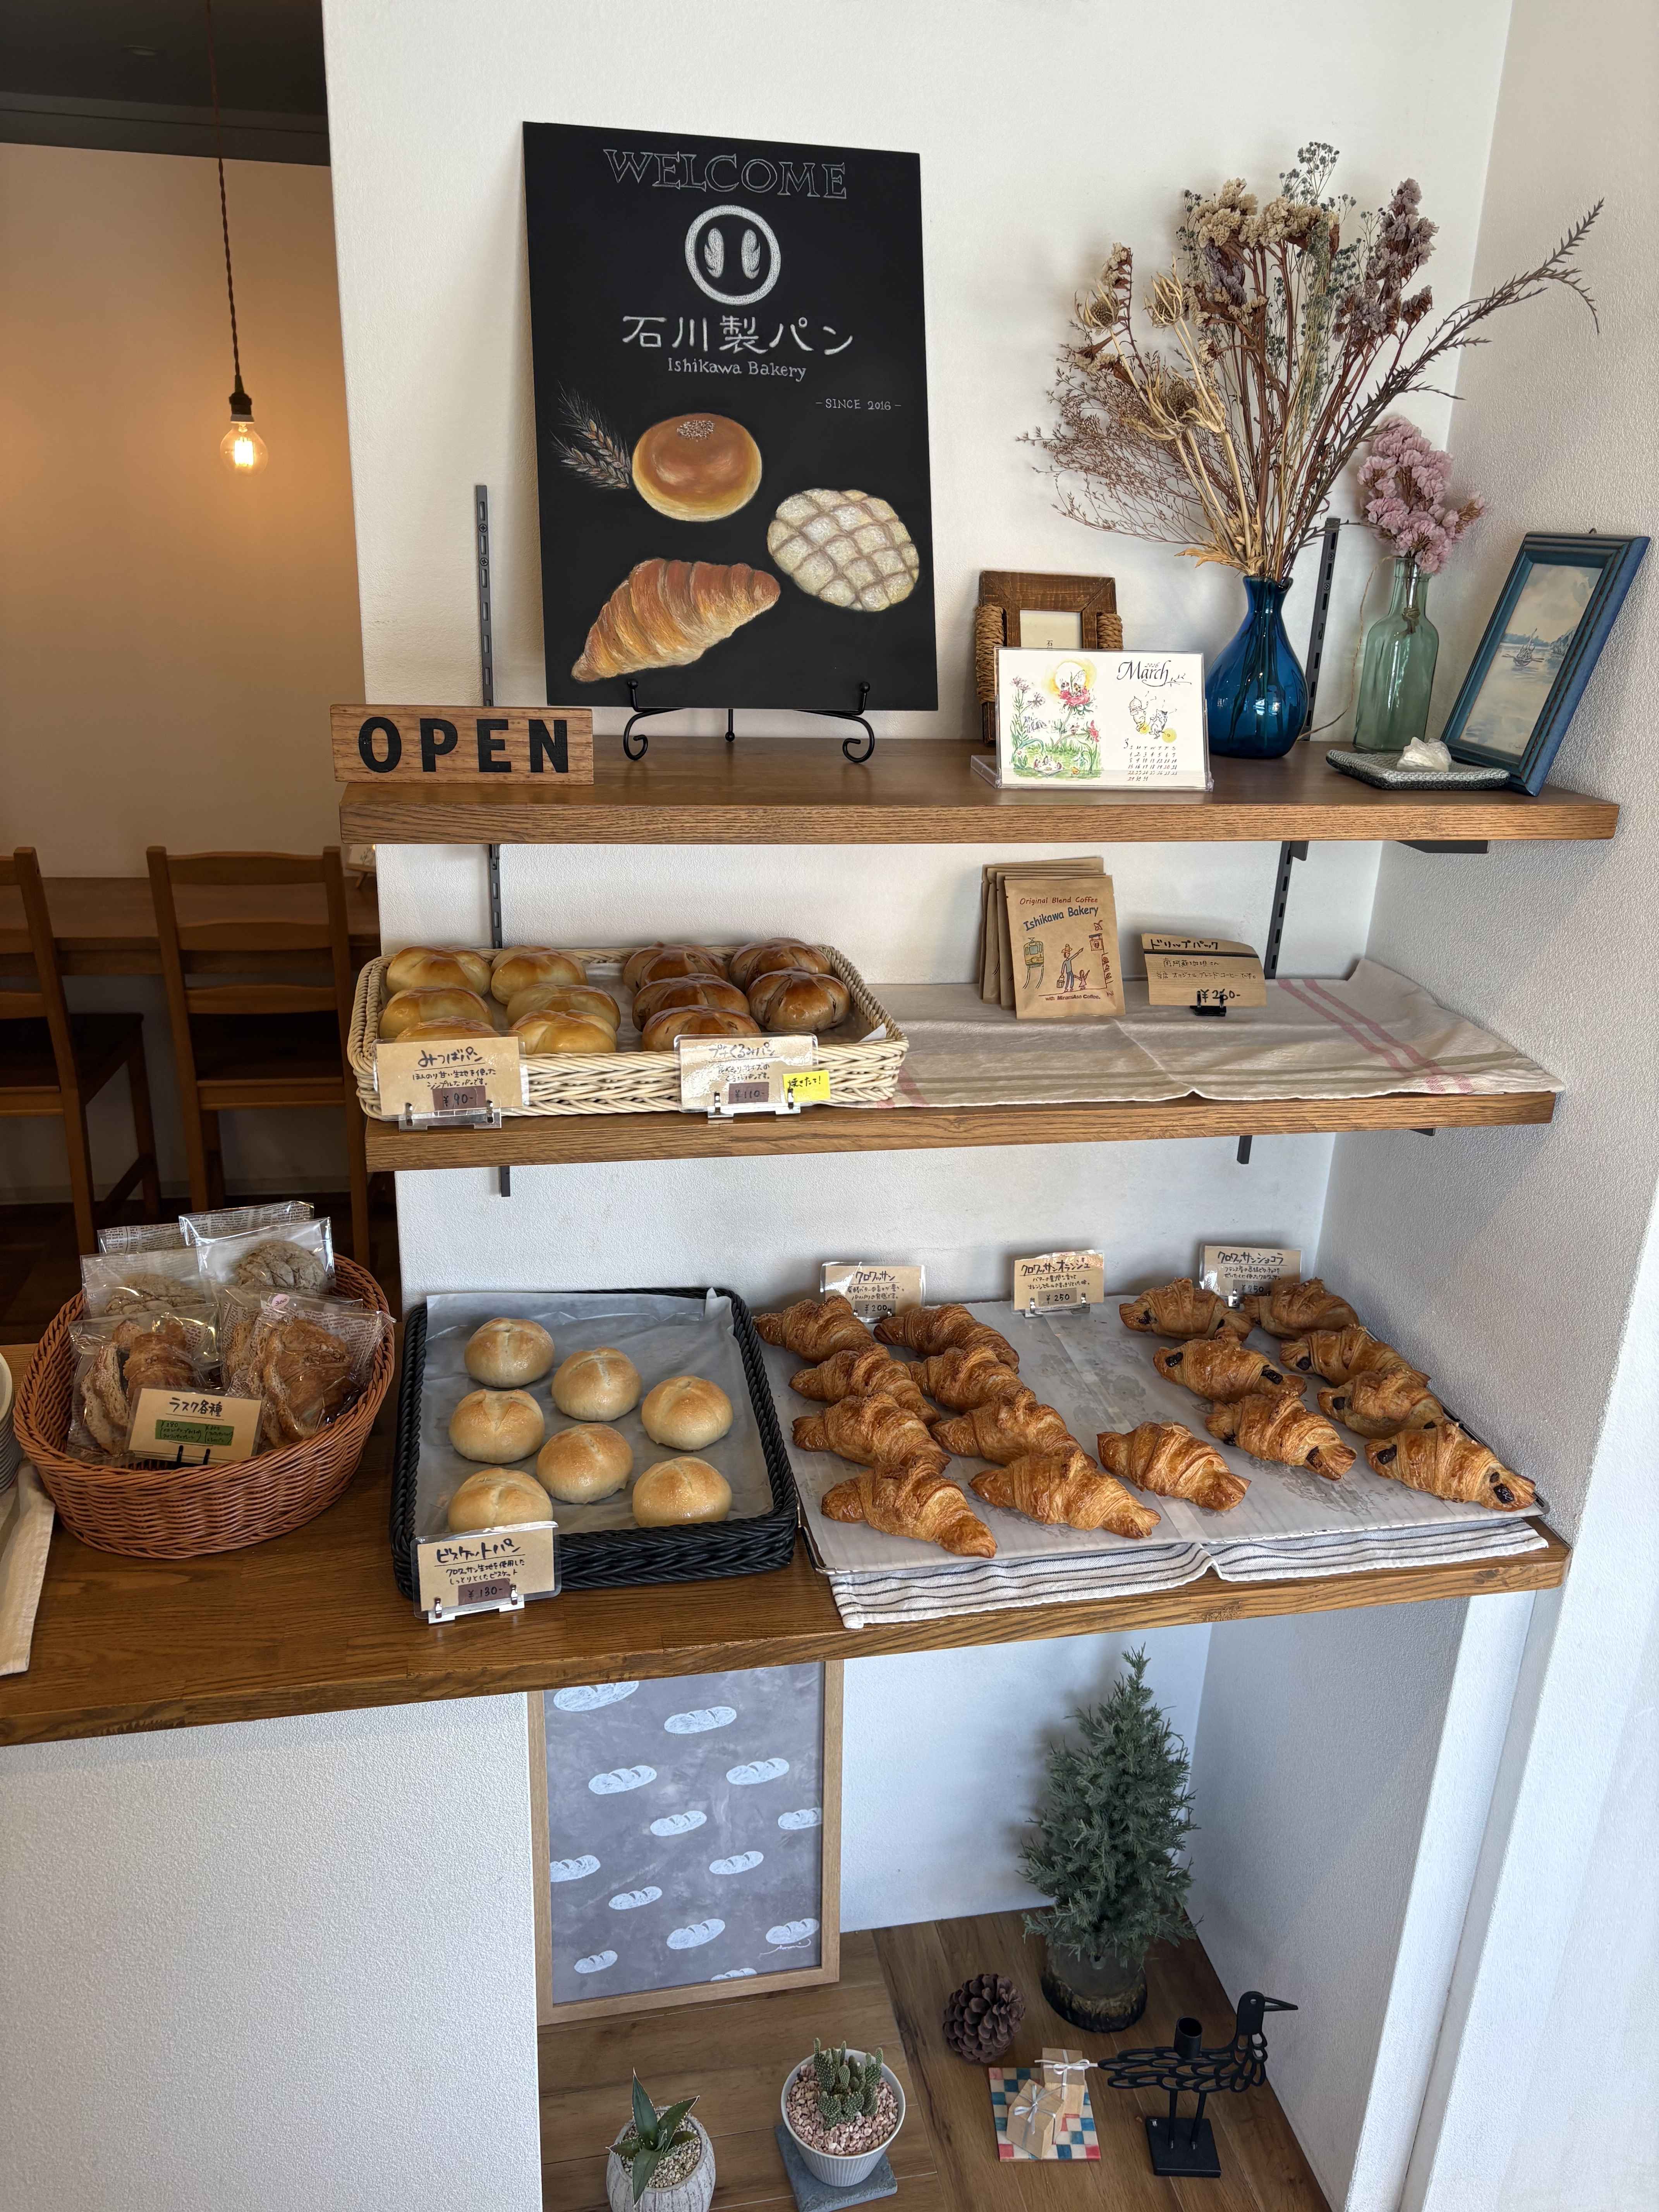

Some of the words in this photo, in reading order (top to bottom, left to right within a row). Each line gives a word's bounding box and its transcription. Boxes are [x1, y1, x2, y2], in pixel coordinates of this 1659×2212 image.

[603, 148, 847, 199] WELCOME
[622, 316, 853, 355] 石川製パン
[668, 357, 742, 375] Ishikawa
[748, 361, 807, 382] Bakery
[1116, 660, 1171, 687] March
[359, 717, 568, 773] OPEN
[1020, 897, 1048, 905] Original
[1023, 912, 1064, 931] Ishikawa
[1068, 905, 1098, 917] Bakery
[1151, 939, 1218, 950] ドリップパック
[417, 1046, 483, 1067] みつばパン
[708, 1041, 775, 1058] プチくるみパン
[412, 1068, 496, 1080] ほんのり甘い生地を使った
[1021, 1257, 1091, 1276] クロワッサンオランジュ
[1218, 1251, 1283, 1265] クロワッサンショコラ
[855, 1271, 895, 1284] クロワッサン
[1046, 1294, 1070, 1304] ¥250
[169, 1397, 223, 1417] ラスク各種
[436, 1538, 521, 1564] ビスケットパン
